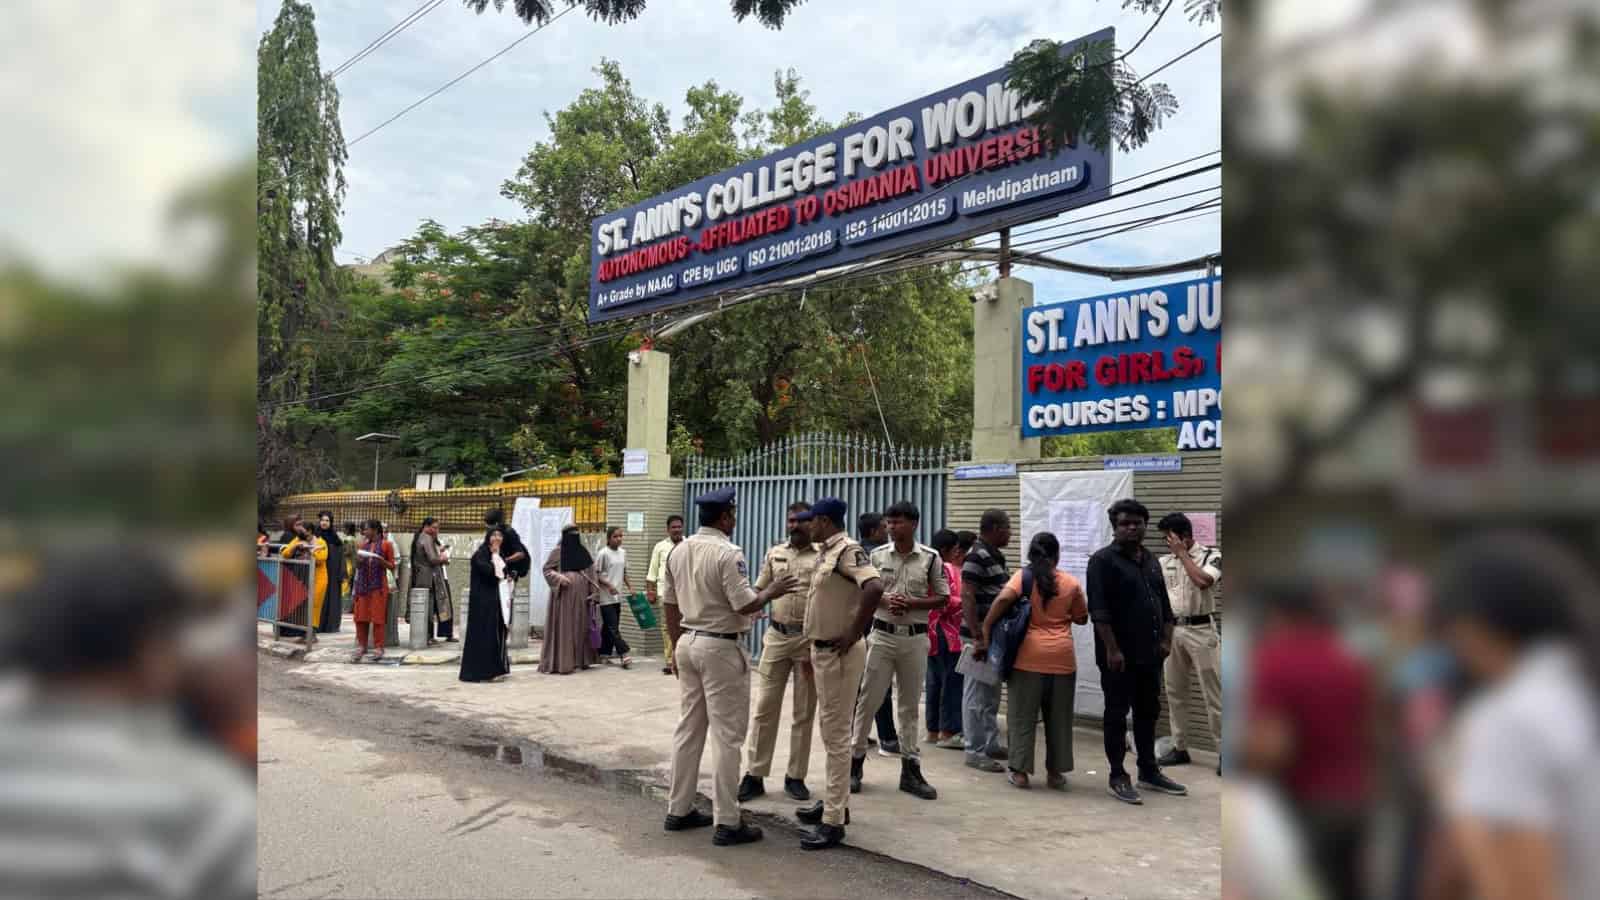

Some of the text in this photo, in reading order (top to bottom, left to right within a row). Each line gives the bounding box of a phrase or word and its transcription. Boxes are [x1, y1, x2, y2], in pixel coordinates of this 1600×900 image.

[597, 80, 1050, 255] ST. ANN'S COLLEGE FOR WOM
[963, 165, 1078, 209] Mehdipatnam
[598, 235, 688, 281] AUTONOMOUS
[701, 203, 790, 252] AFFILIATED
[794, 194, 819, 225] TO
[824, 163, 920, 216] OSMANIA
[924, 126, 1073, 184] UNIVERSI
[845, 198, 946, 241] ISO 14001:2015
[683, 256, 738, 283] CPE by UGC
[748, 230, 832, 267] ISO 21001:2018
[597, 274, 674, 306] A+ Grade by NAAC
[1026, 280, 1221, 354] ST. ANN'S JU
[1027, 360, 1087, 395] FOR
[1095, 346, 1204, 387] GIRLS,
[1028, 387, 1222, 428] COURSES : MP
